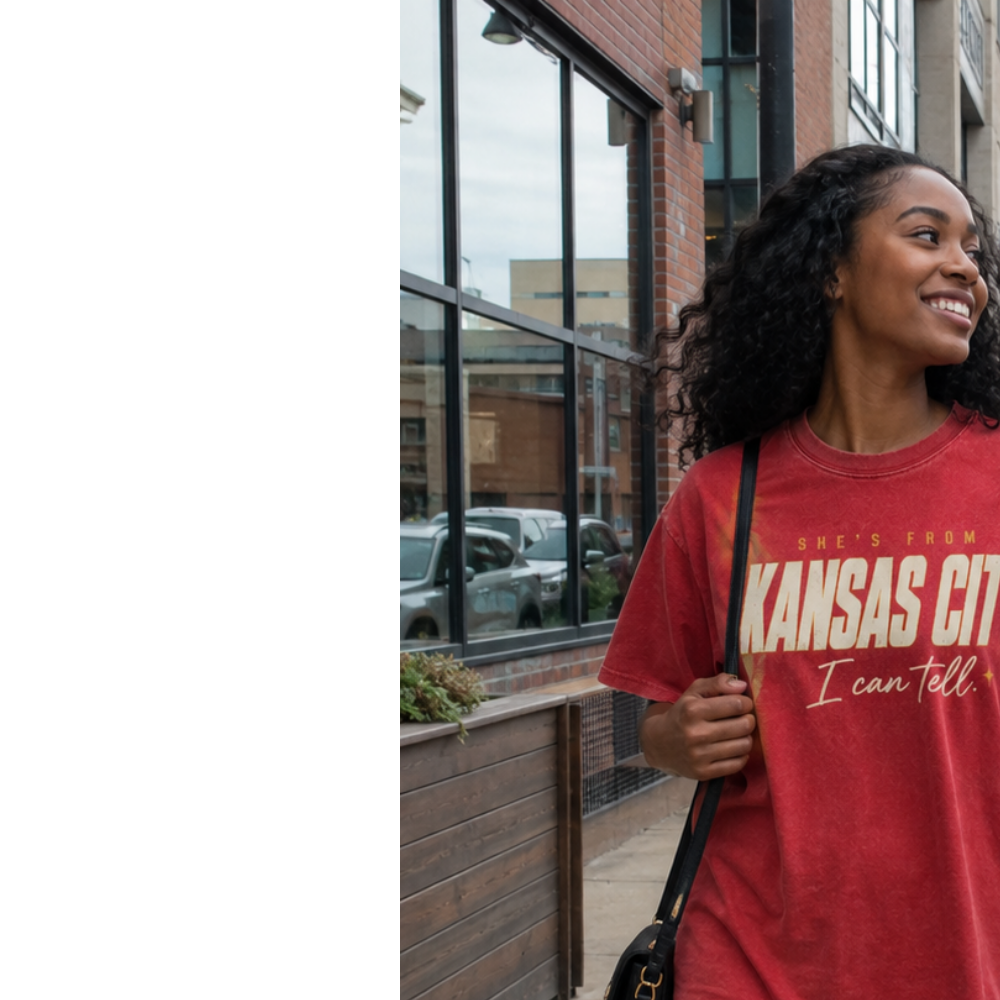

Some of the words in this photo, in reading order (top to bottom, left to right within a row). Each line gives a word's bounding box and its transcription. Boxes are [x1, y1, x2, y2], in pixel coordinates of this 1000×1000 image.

[798, 533, 880, 551] SHE'S
[907, 530, 976, 546] FROM
[740, 555, 928, 654] KANSAS
[806, 658, 855, 709] I
[852, 673, 911, 695] can
[909, 655, 978, 703] tell.
